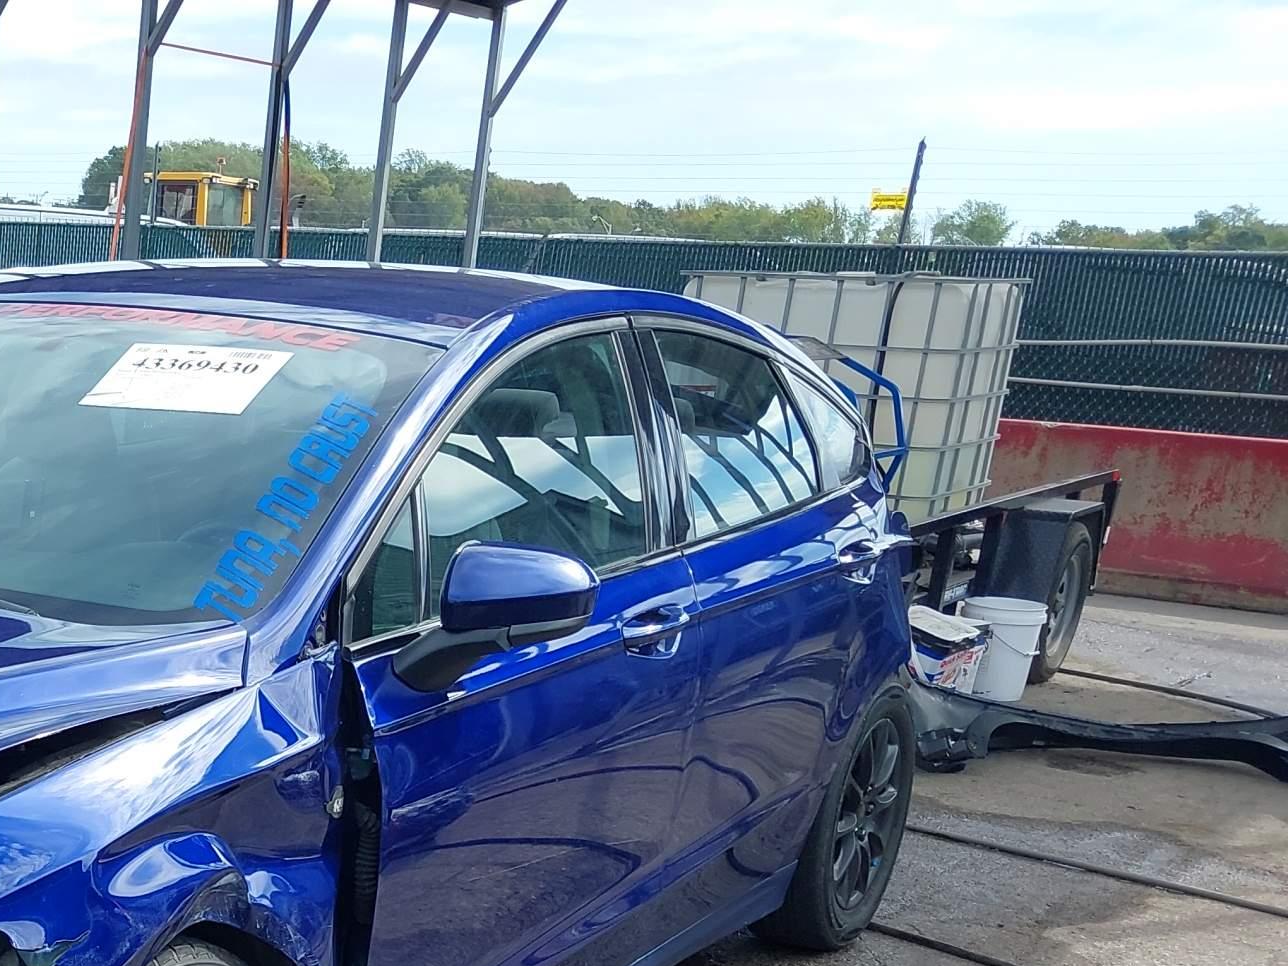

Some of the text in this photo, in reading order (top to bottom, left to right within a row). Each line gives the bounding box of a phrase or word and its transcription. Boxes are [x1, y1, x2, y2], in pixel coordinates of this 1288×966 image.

[132, 357, 260, 375] 43369430
[193, 529, 301, 624] TUNA,
[255, 475, 319, 533] NO
